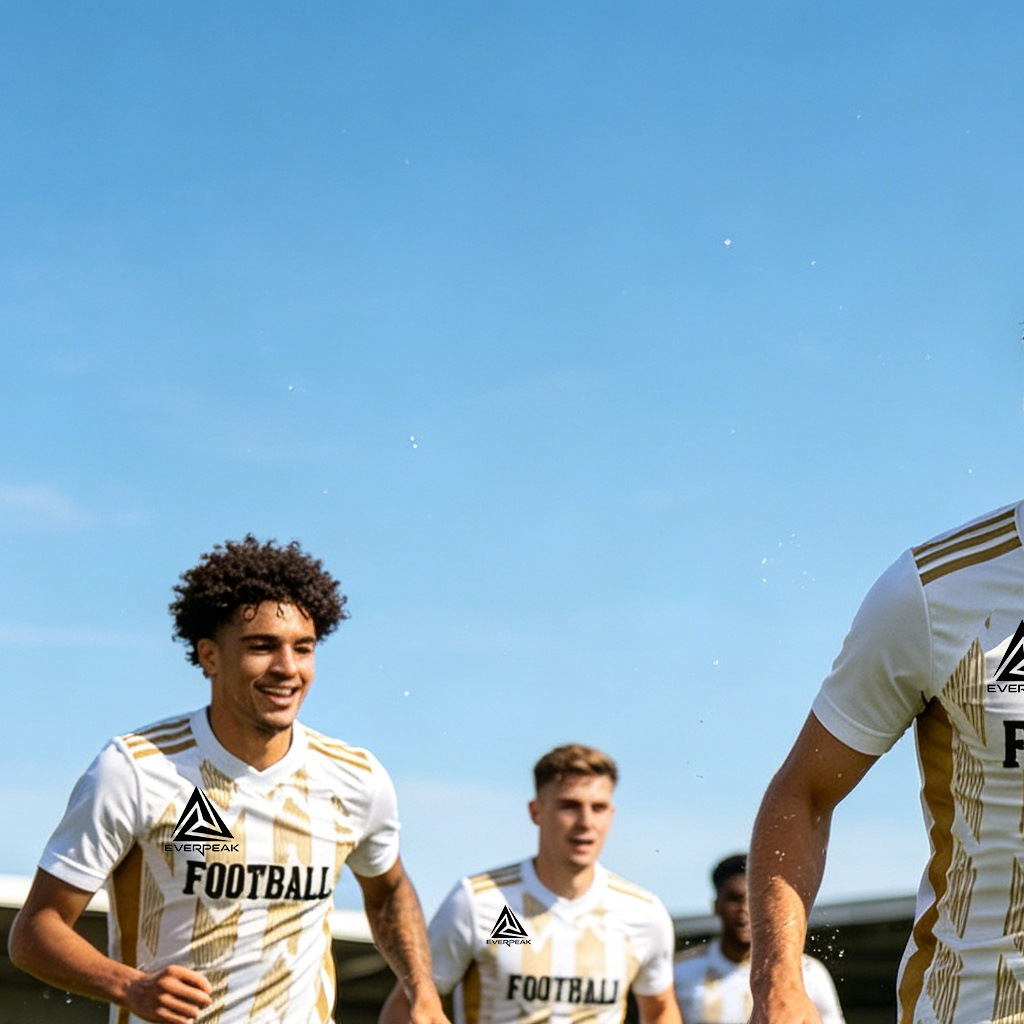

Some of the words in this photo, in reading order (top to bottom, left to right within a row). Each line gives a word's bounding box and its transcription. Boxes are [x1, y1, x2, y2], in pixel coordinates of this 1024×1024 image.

[164, 844, 239, 856] EVERPEAK
[182, 860, 332, 901] FOOTBALL
[486, 939, 531, 947] EVERPEAK
[506, 974, 620, 1006] FOOTBALL
